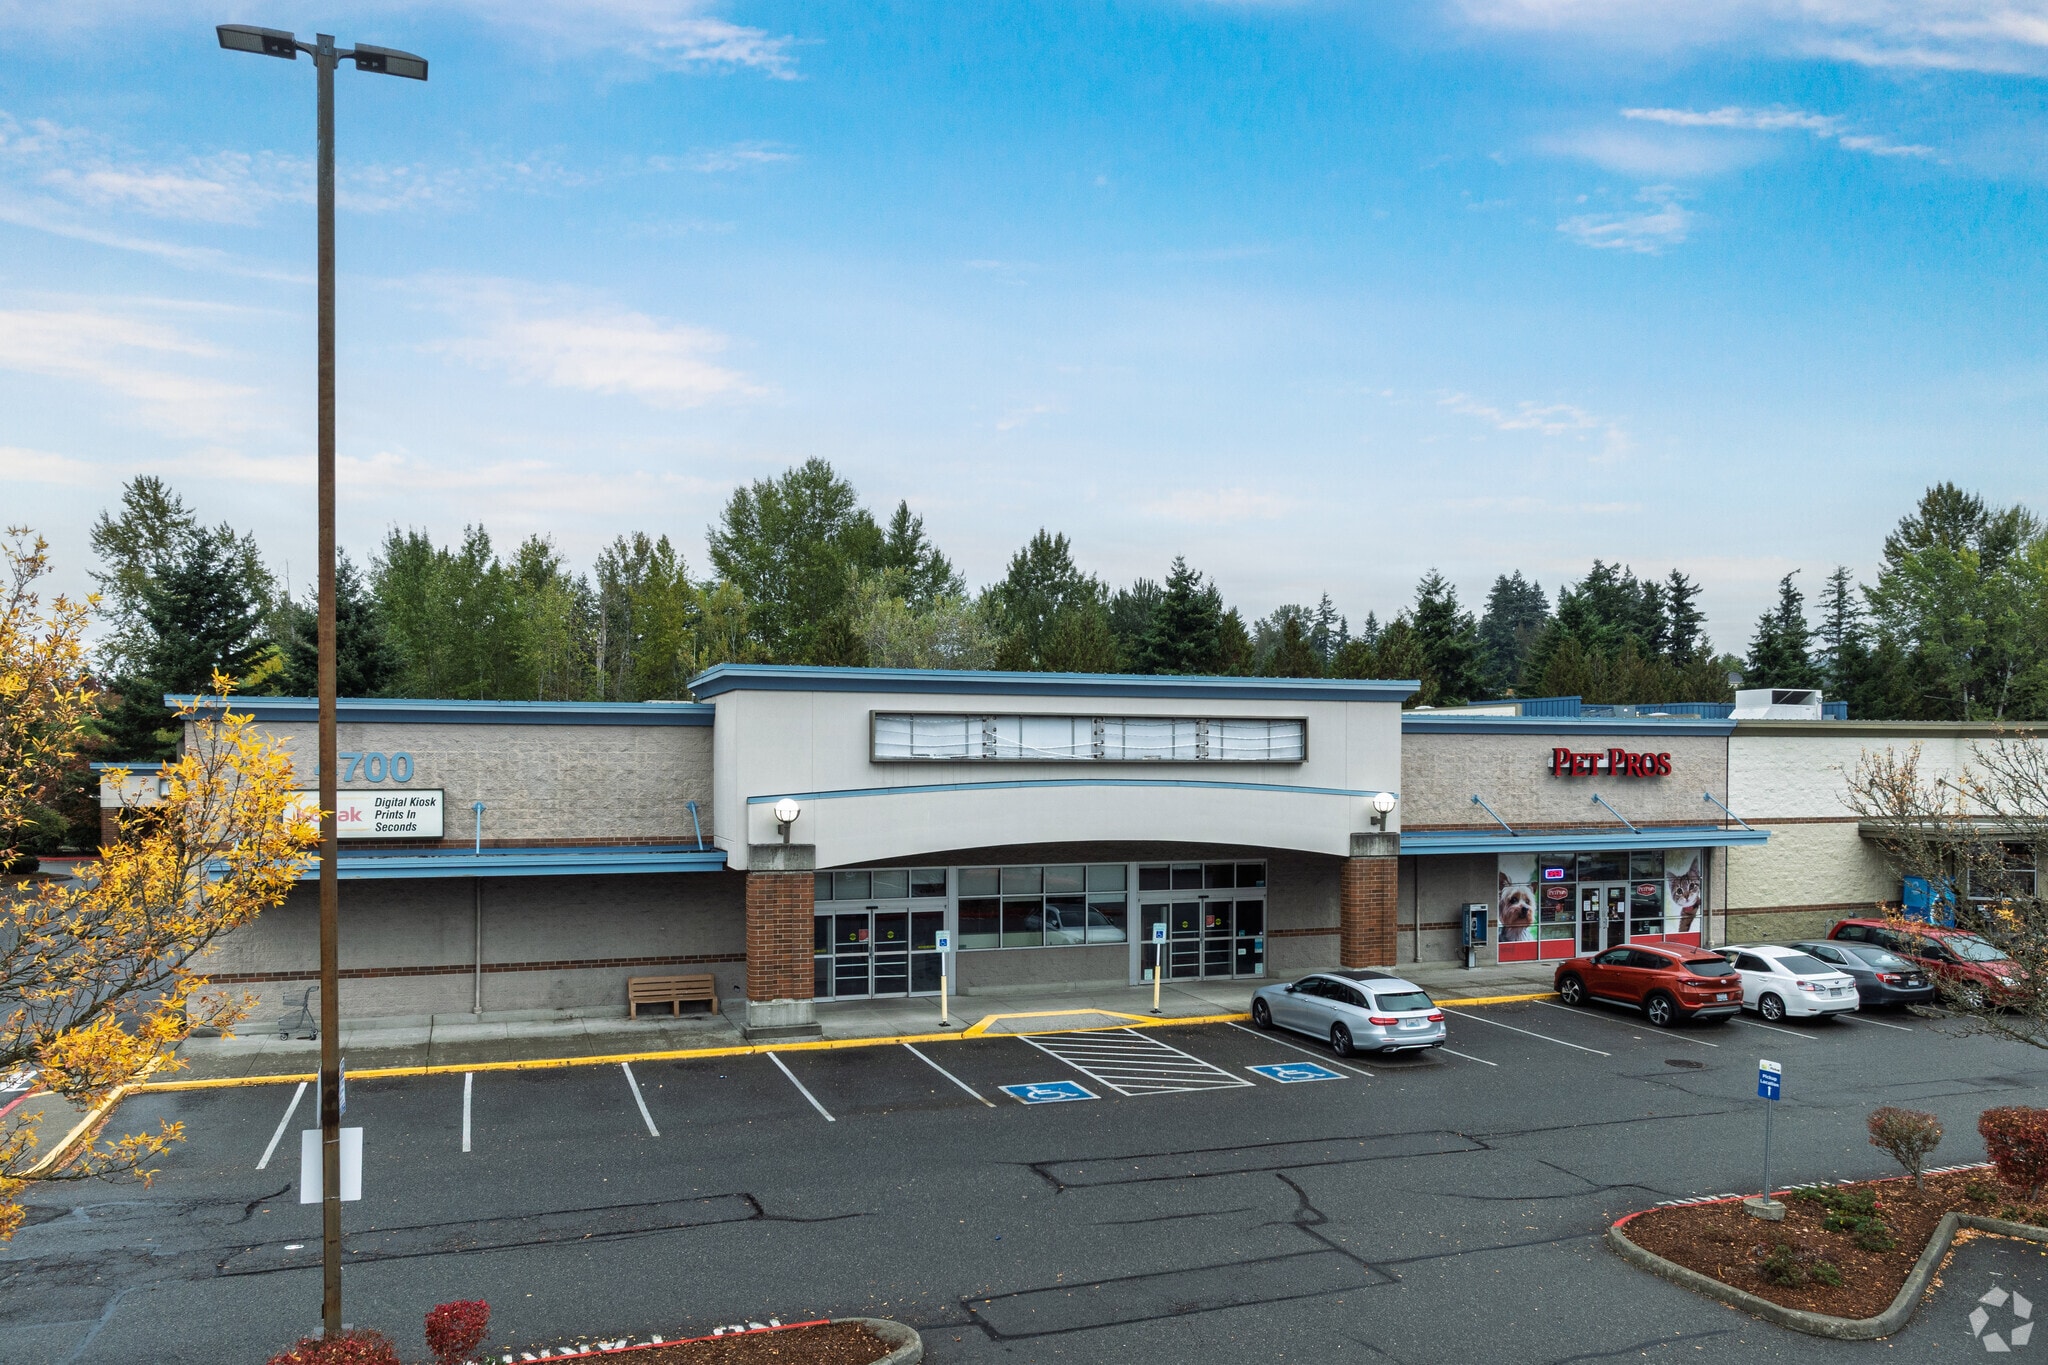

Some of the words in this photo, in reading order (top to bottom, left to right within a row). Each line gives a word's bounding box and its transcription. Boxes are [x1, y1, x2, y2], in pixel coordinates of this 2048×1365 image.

[314, 752, 415, 783] 700
[1552, 748, 1604, 777] PET
[1607, 748, 1672, 777] PROS
[375, 797, 408, 809] Digital
[409, 797, 437, 807] Kiosk
[375, 810, 404, 820] Prints
[406, 809, 417, 819] In
[375, 822, 417, 832] Seconds
